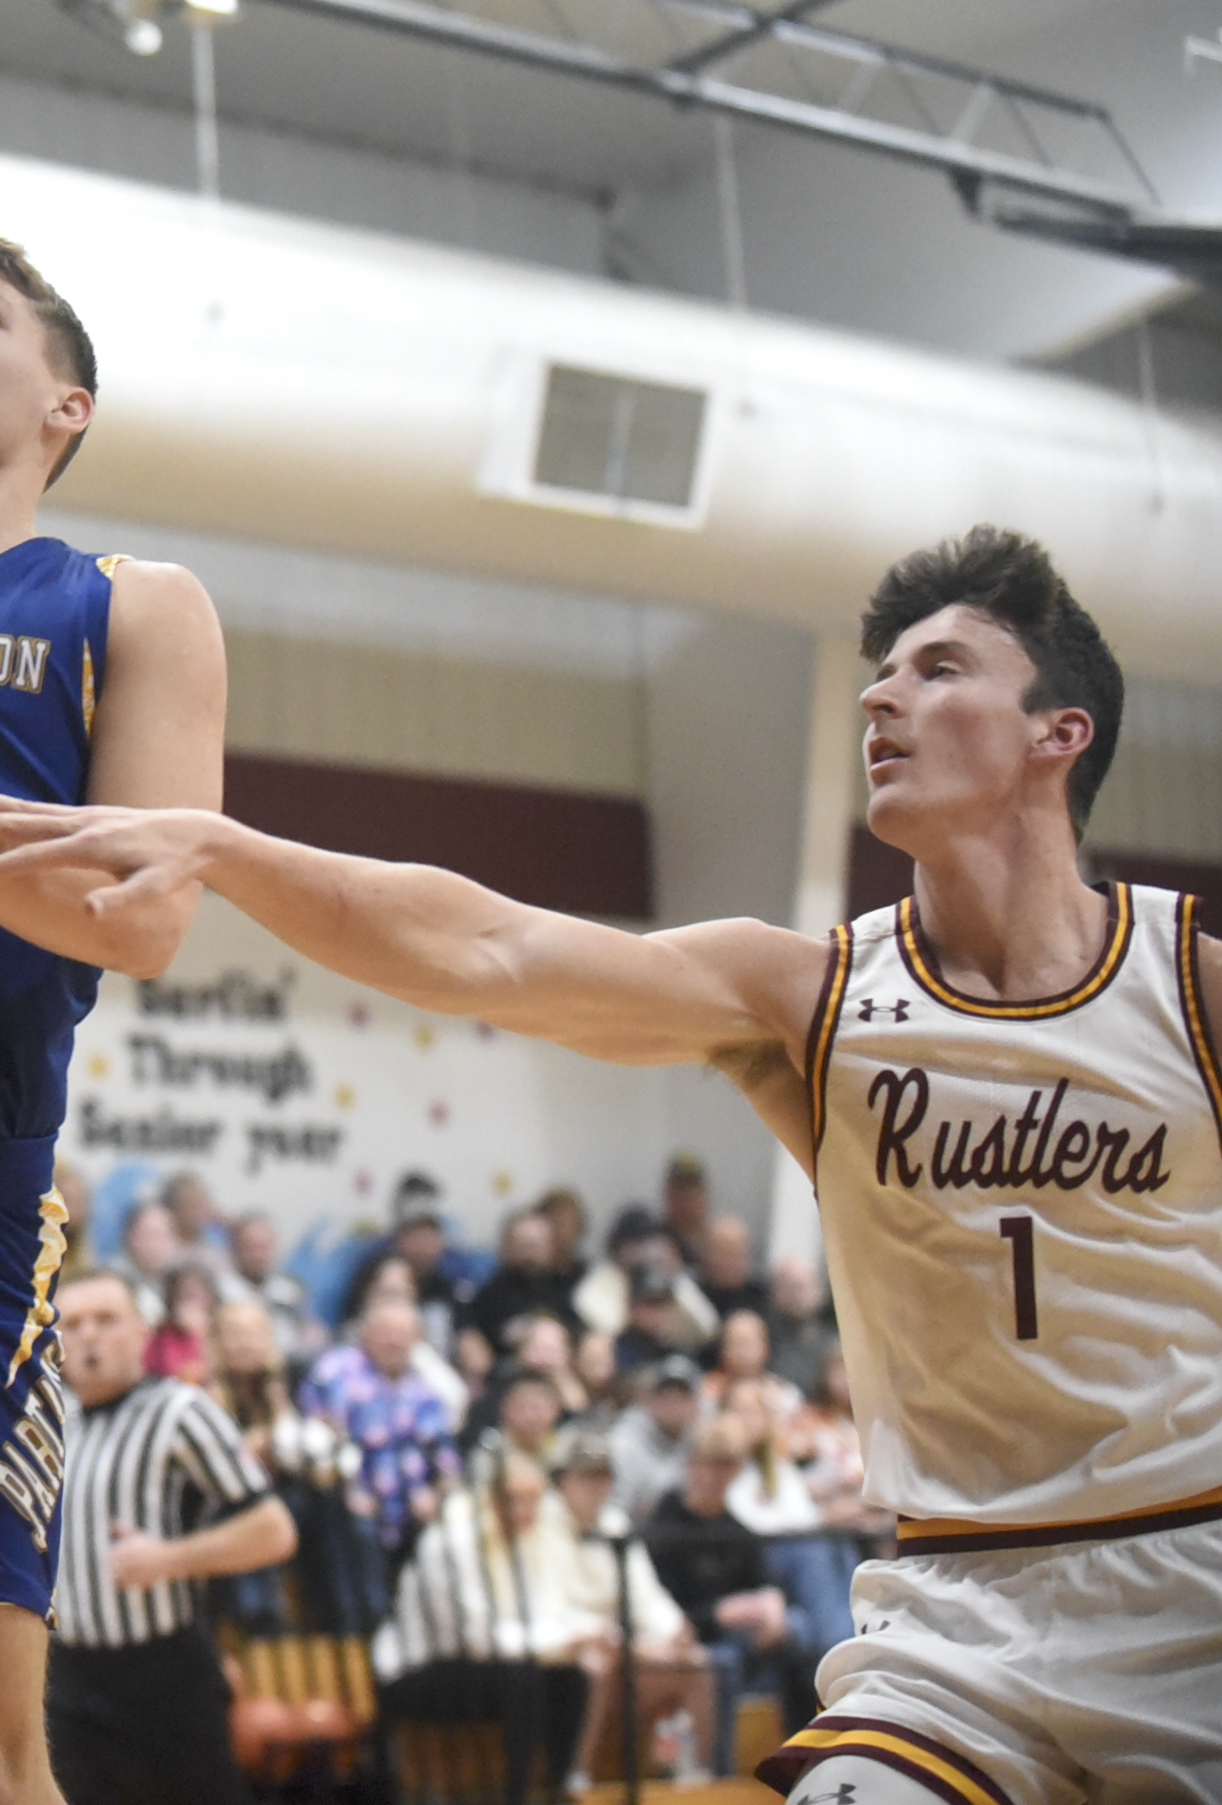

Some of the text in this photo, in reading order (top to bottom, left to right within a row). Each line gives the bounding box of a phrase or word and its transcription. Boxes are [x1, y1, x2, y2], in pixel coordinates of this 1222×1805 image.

[127, 1033, 312, 1102] Through
[79, 1098, 344, 1175] Senior year
[867, 1067, 1172, 1194] Rustlers
[999, 1216, 1038, 1340] 1
